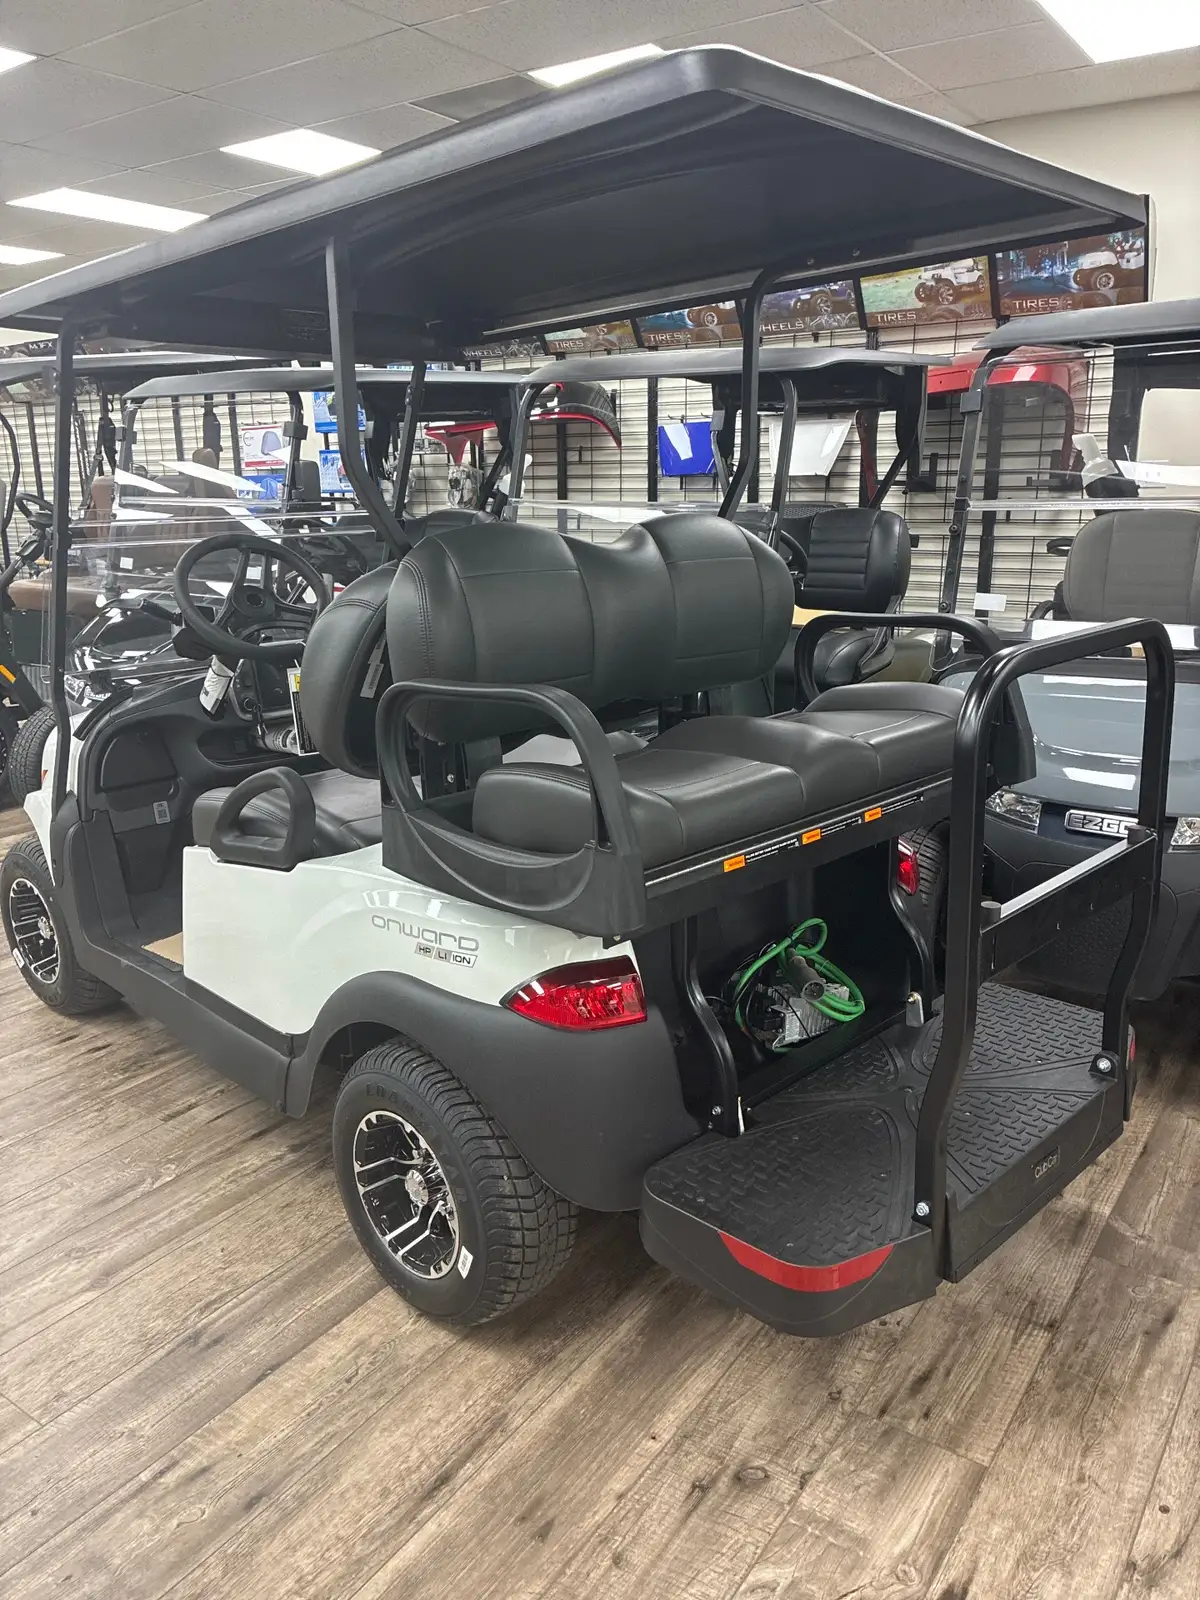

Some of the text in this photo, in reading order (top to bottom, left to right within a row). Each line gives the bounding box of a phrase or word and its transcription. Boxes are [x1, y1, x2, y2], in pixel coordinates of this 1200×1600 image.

[1012, 297, 1060, 309] TIRES
[875, 311, 917, 323] TIRES
[759, 320, 804, 332] HEELS
[647, 332, 682, 342] TIRES
[554, 339, 584, 349] TIRES
[463, 346, 502, 357] WHEELS
[418, 945, 432, 955] HP
[452, 954, 471, 965] ION
